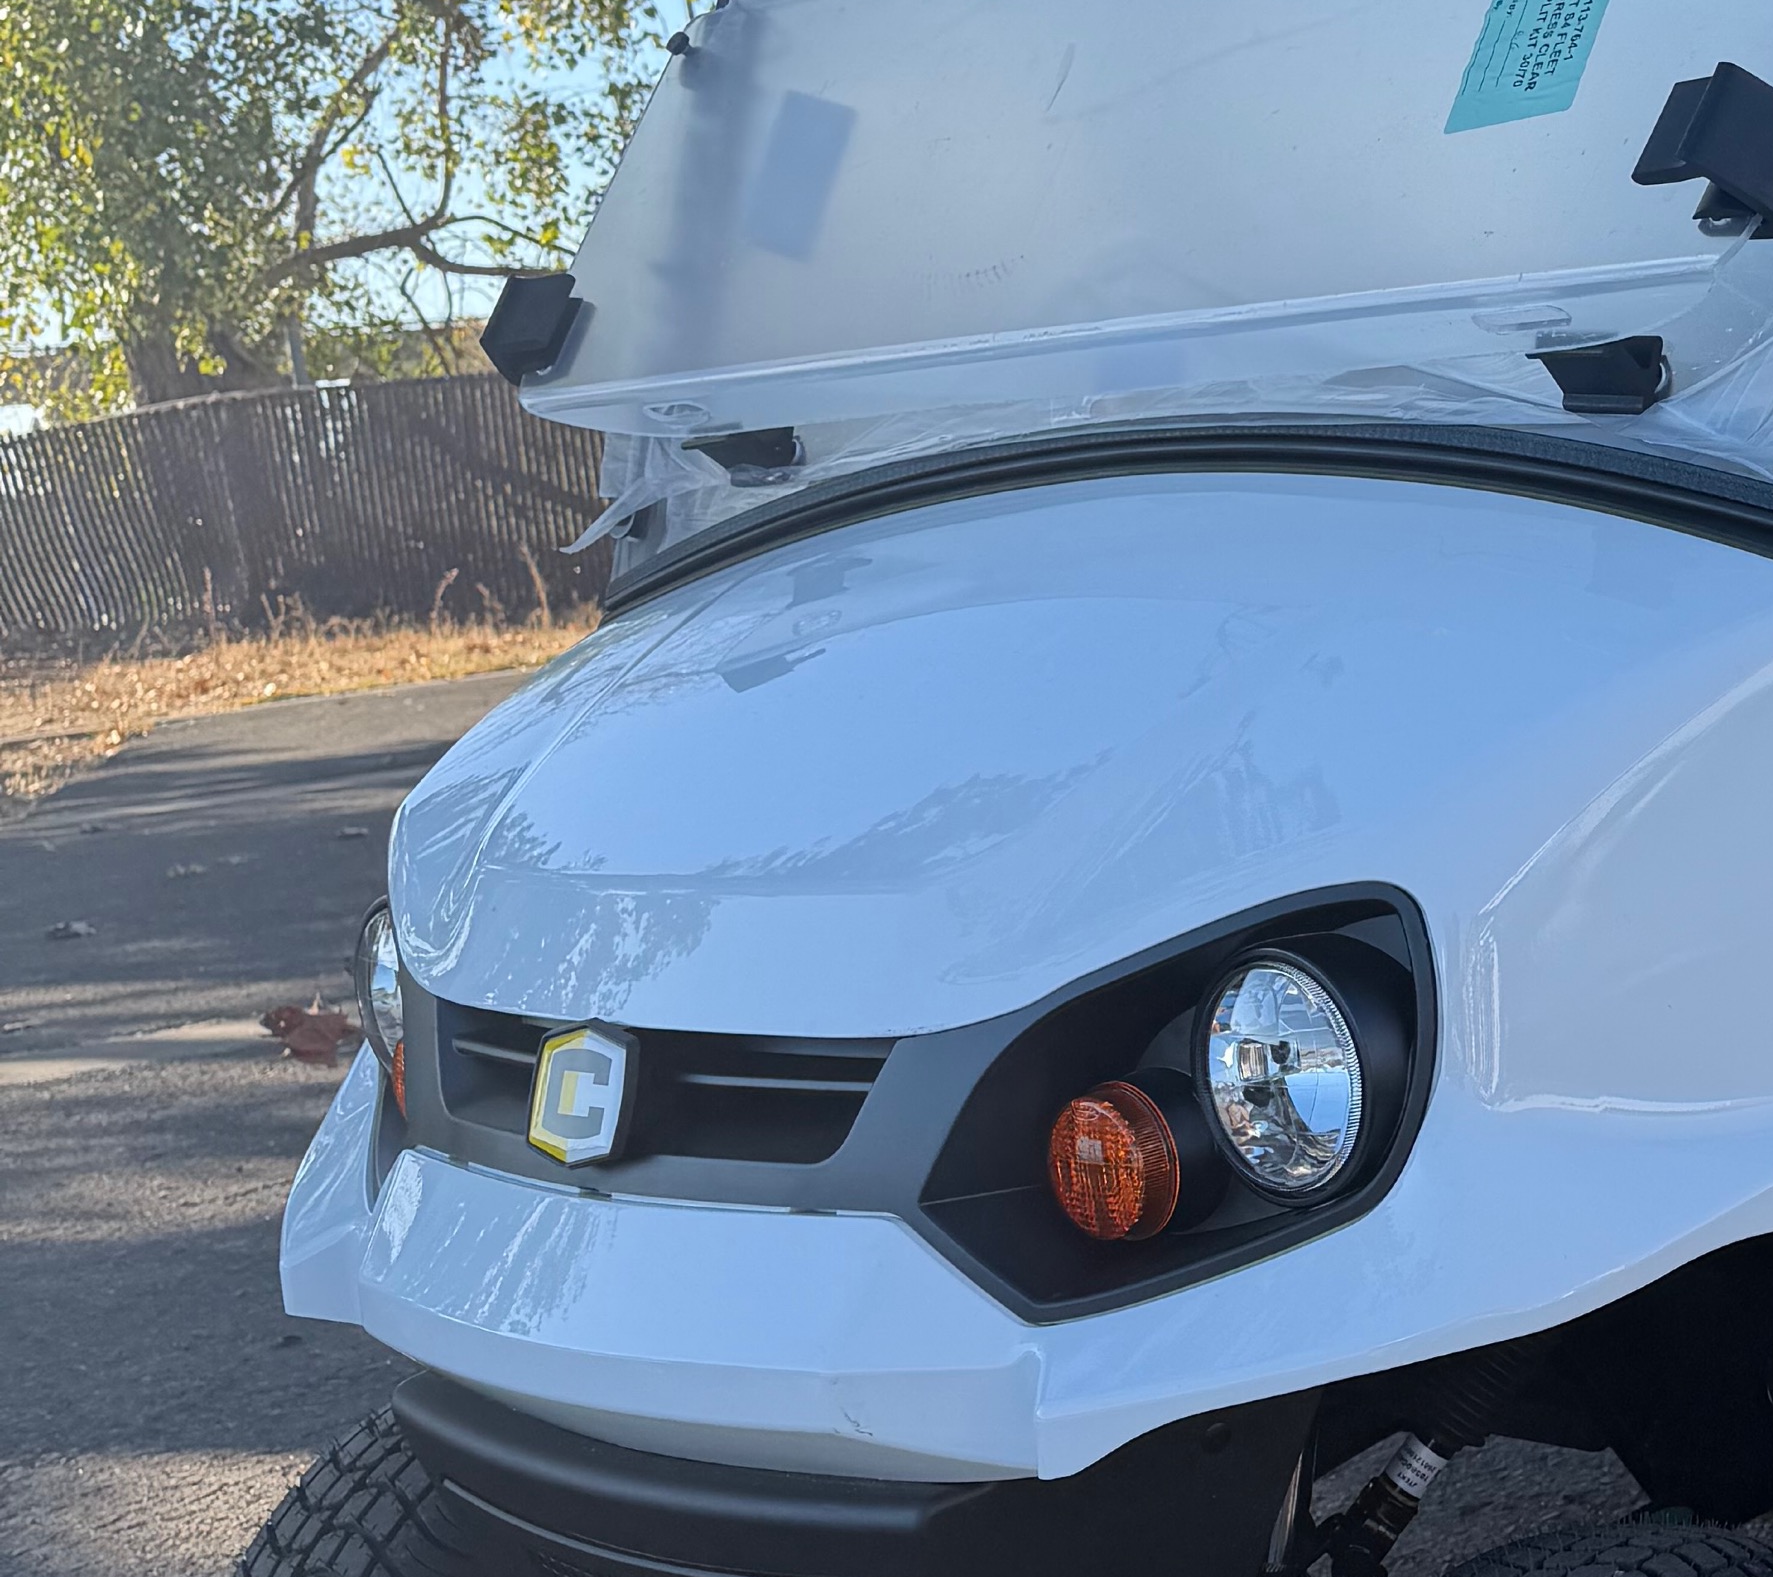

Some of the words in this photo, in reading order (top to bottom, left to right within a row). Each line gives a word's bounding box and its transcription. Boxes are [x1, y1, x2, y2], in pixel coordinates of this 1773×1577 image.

[1528, 27, 1542, 49] KIT
[1544, 32, 1567, 76] FLEET
[1524, 44, 1549, 92] CLEAR
